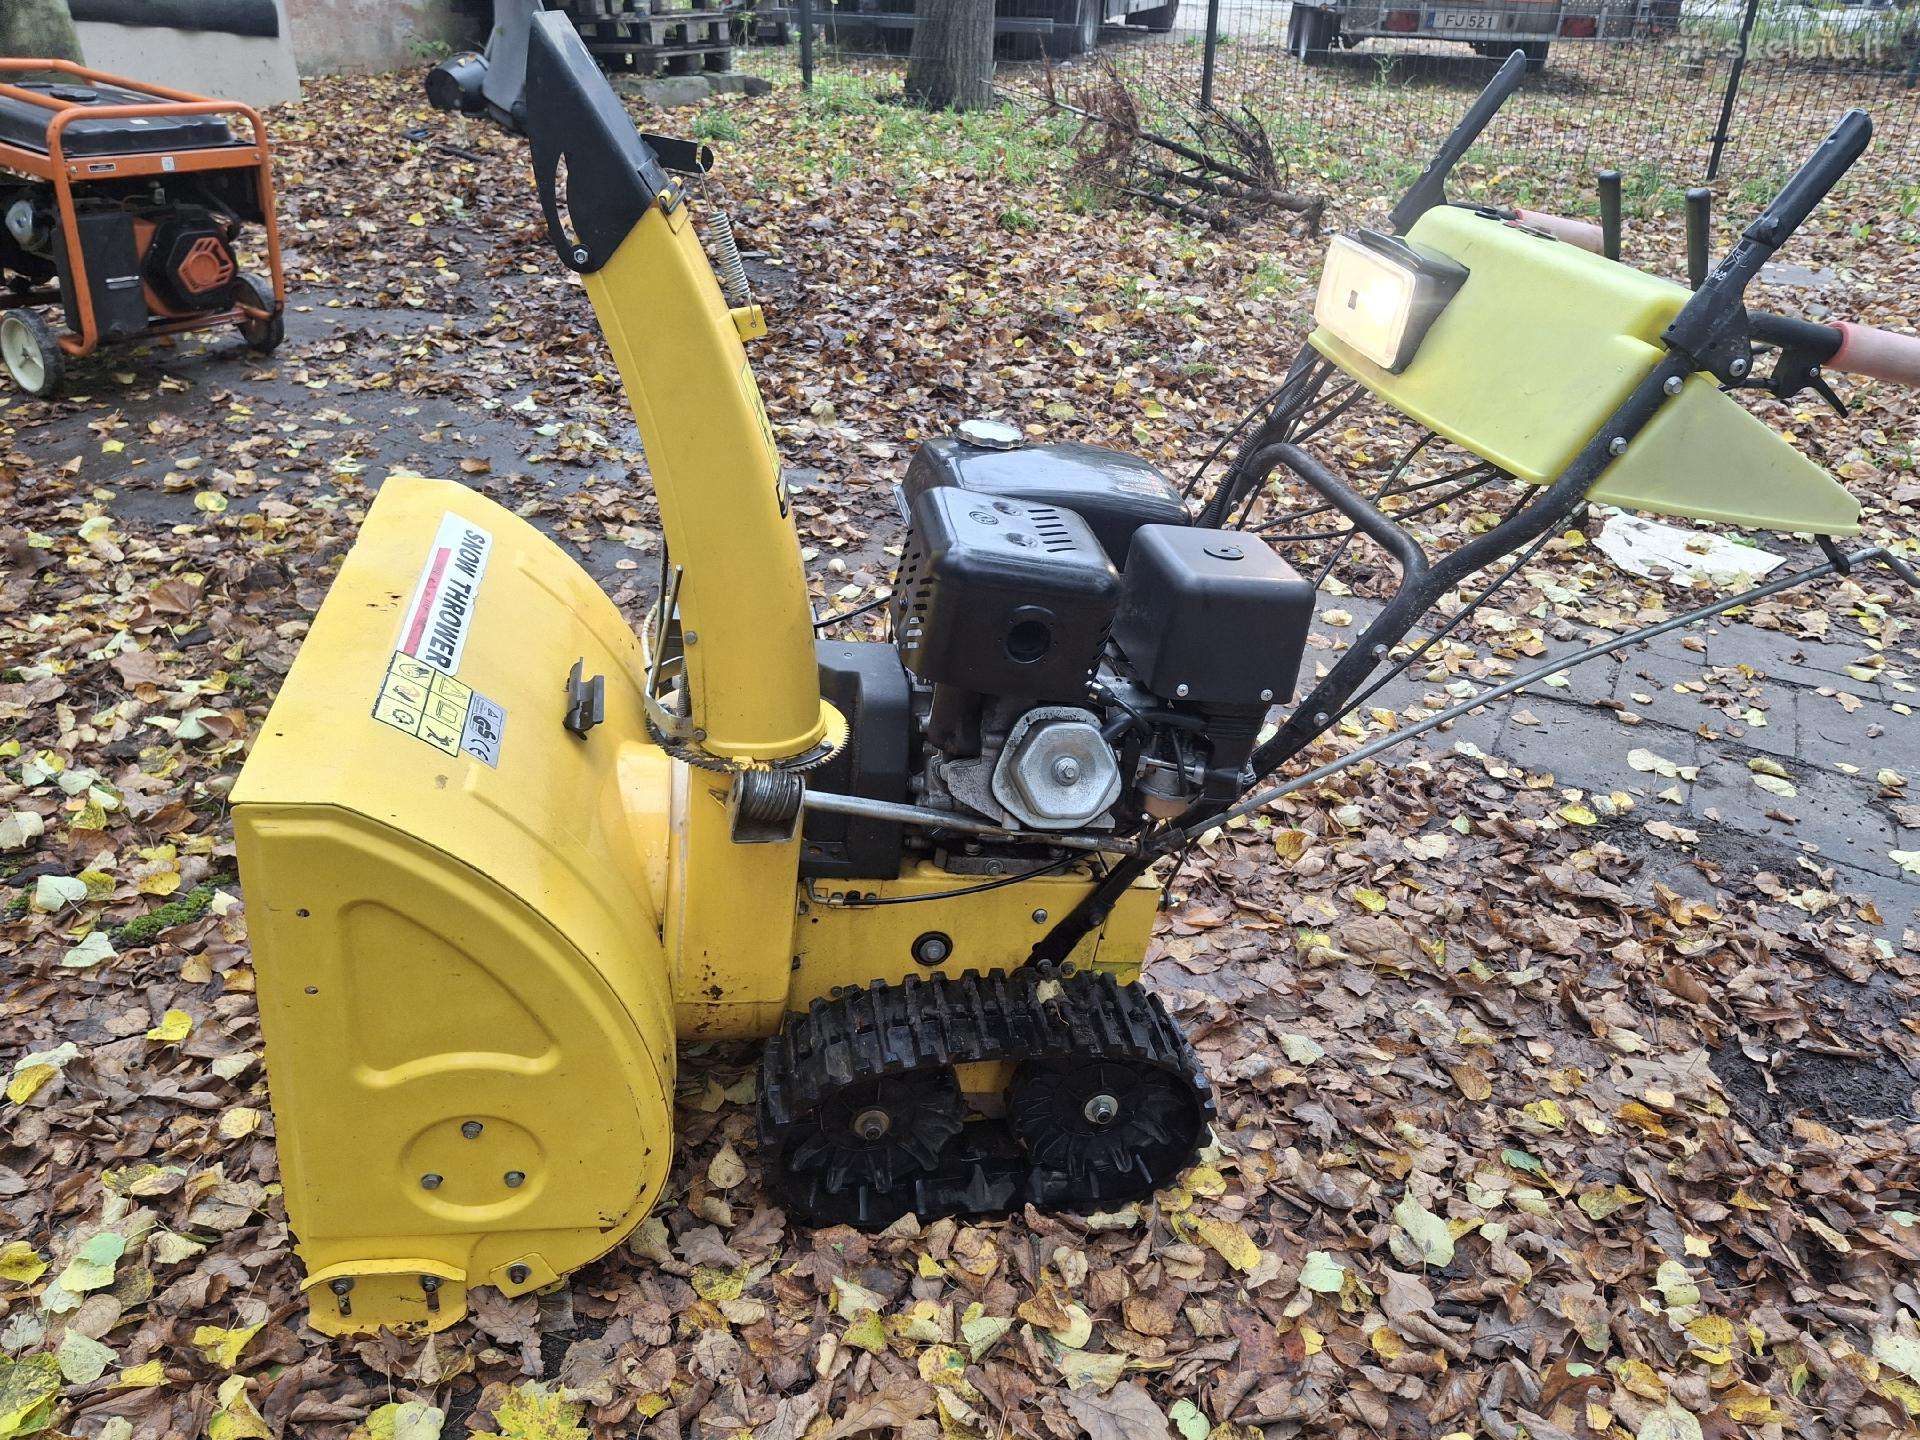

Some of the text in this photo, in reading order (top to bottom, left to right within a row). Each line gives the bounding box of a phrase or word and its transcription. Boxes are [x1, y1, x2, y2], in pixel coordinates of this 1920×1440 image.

[1468, 15, 1493, 28] 521
[454, 529, 486, 579] SNOW
[425, 577, 472, 670] THROWER
